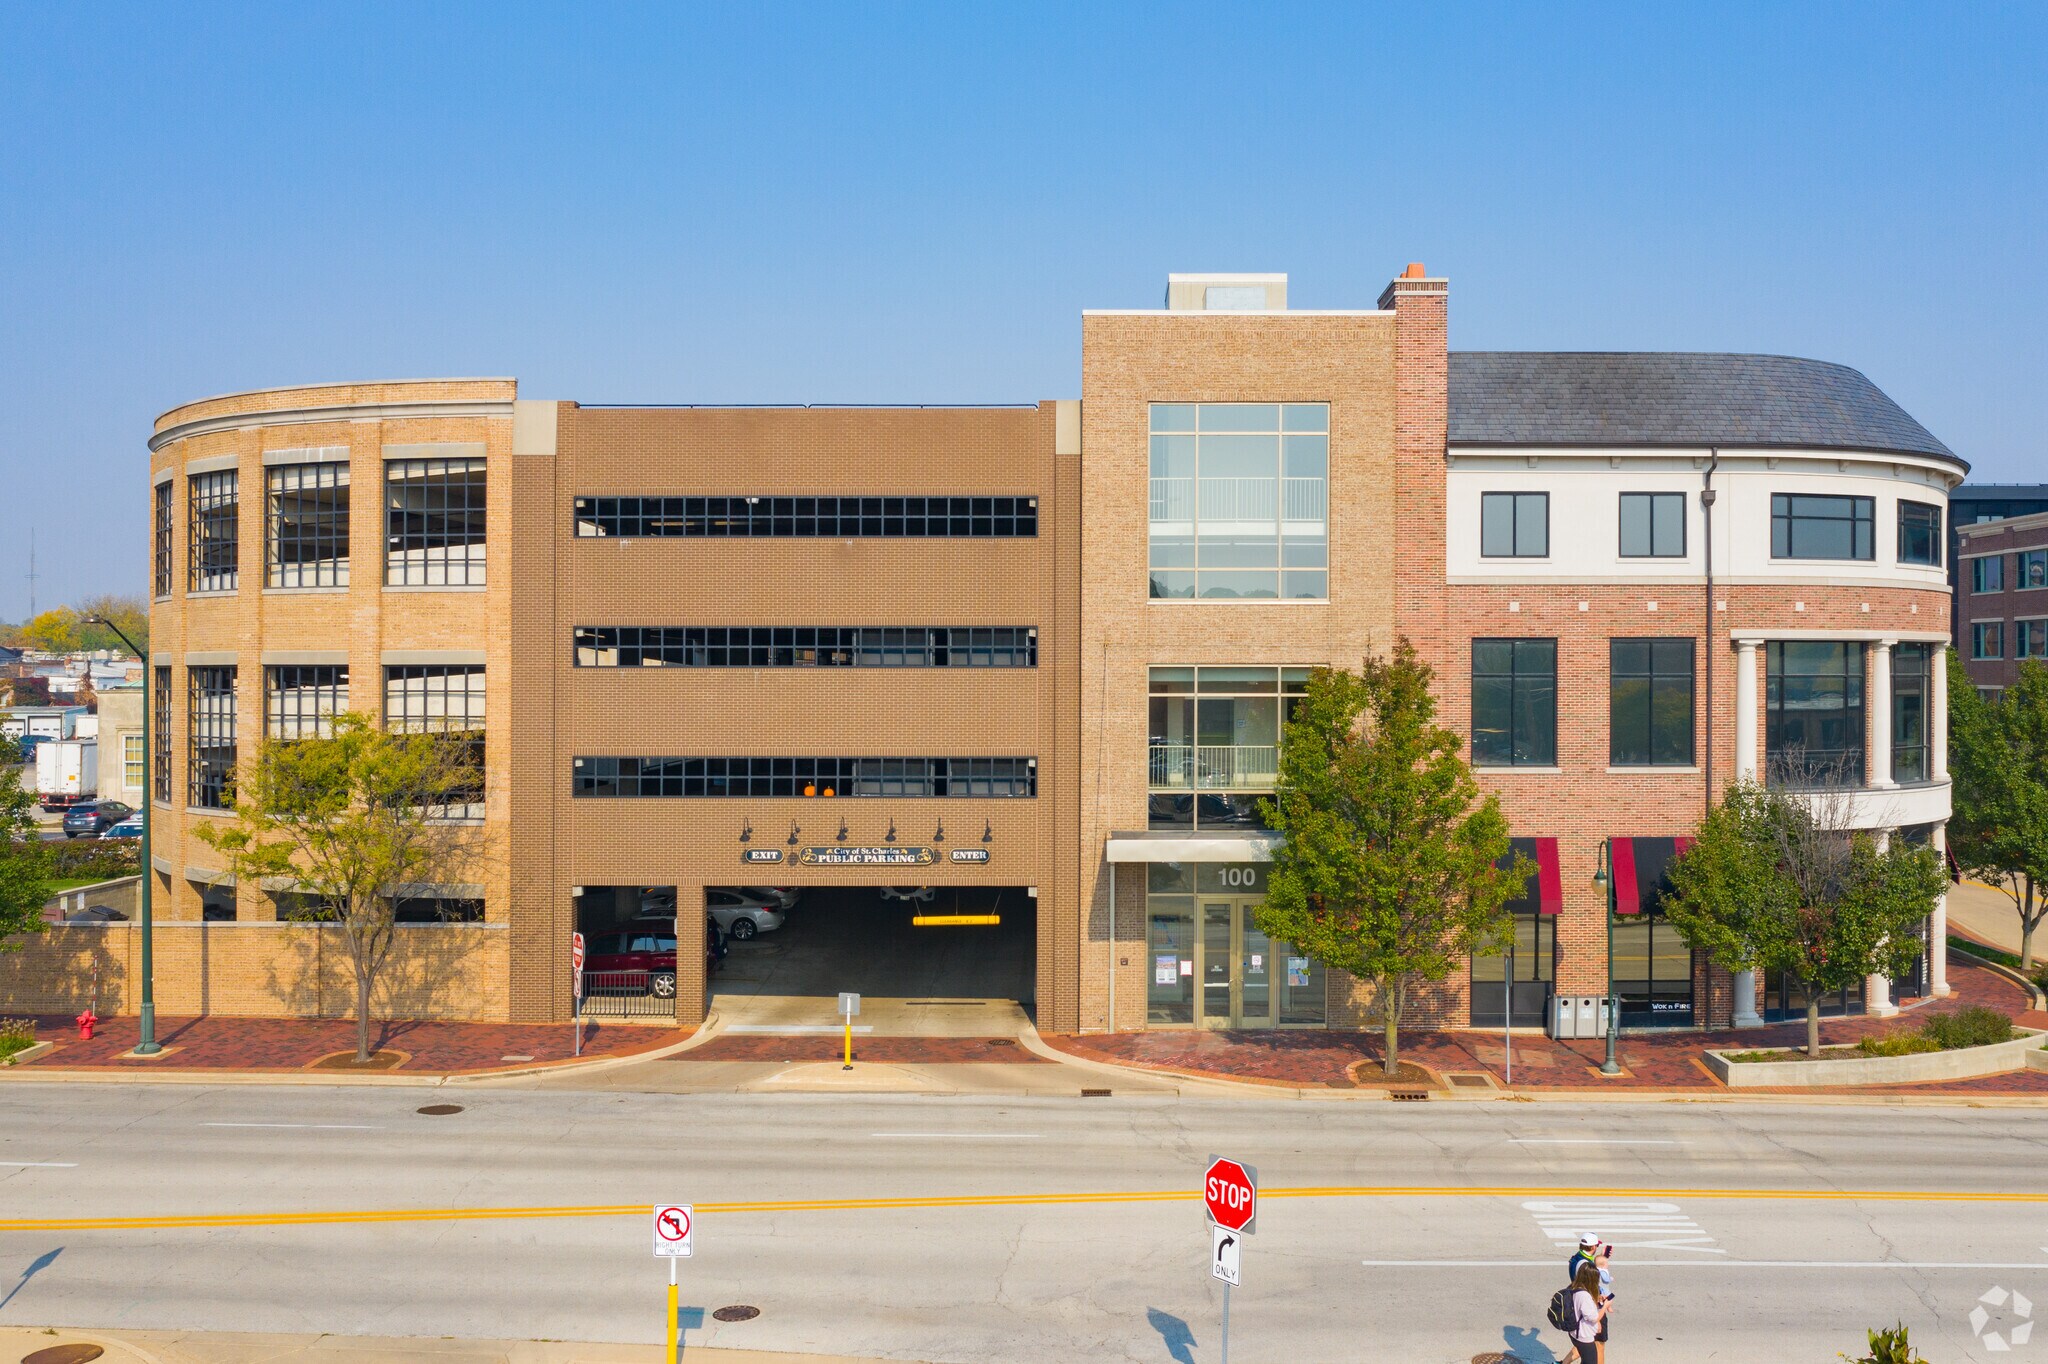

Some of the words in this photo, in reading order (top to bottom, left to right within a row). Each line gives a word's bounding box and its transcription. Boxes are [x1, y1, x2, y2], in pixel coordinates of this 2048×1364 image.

[751, 851, 778, 860] EXIT
[833, 847, 850, 856] City
[851, 847, 860, 855] of
[861, 847, 871, 855] St.
[872, 847, 900, 855] Charles
[952, 851, 987, 860] ENTER
[818, 855, 861, 863] PUBLIC
[864, 855, 915, 863] PARKING
[1218, 868, 1256, 886] 100
[1207, 1176, 1251, 1211] STOP
[1215, 1264, 1237, 1280] ONLY
